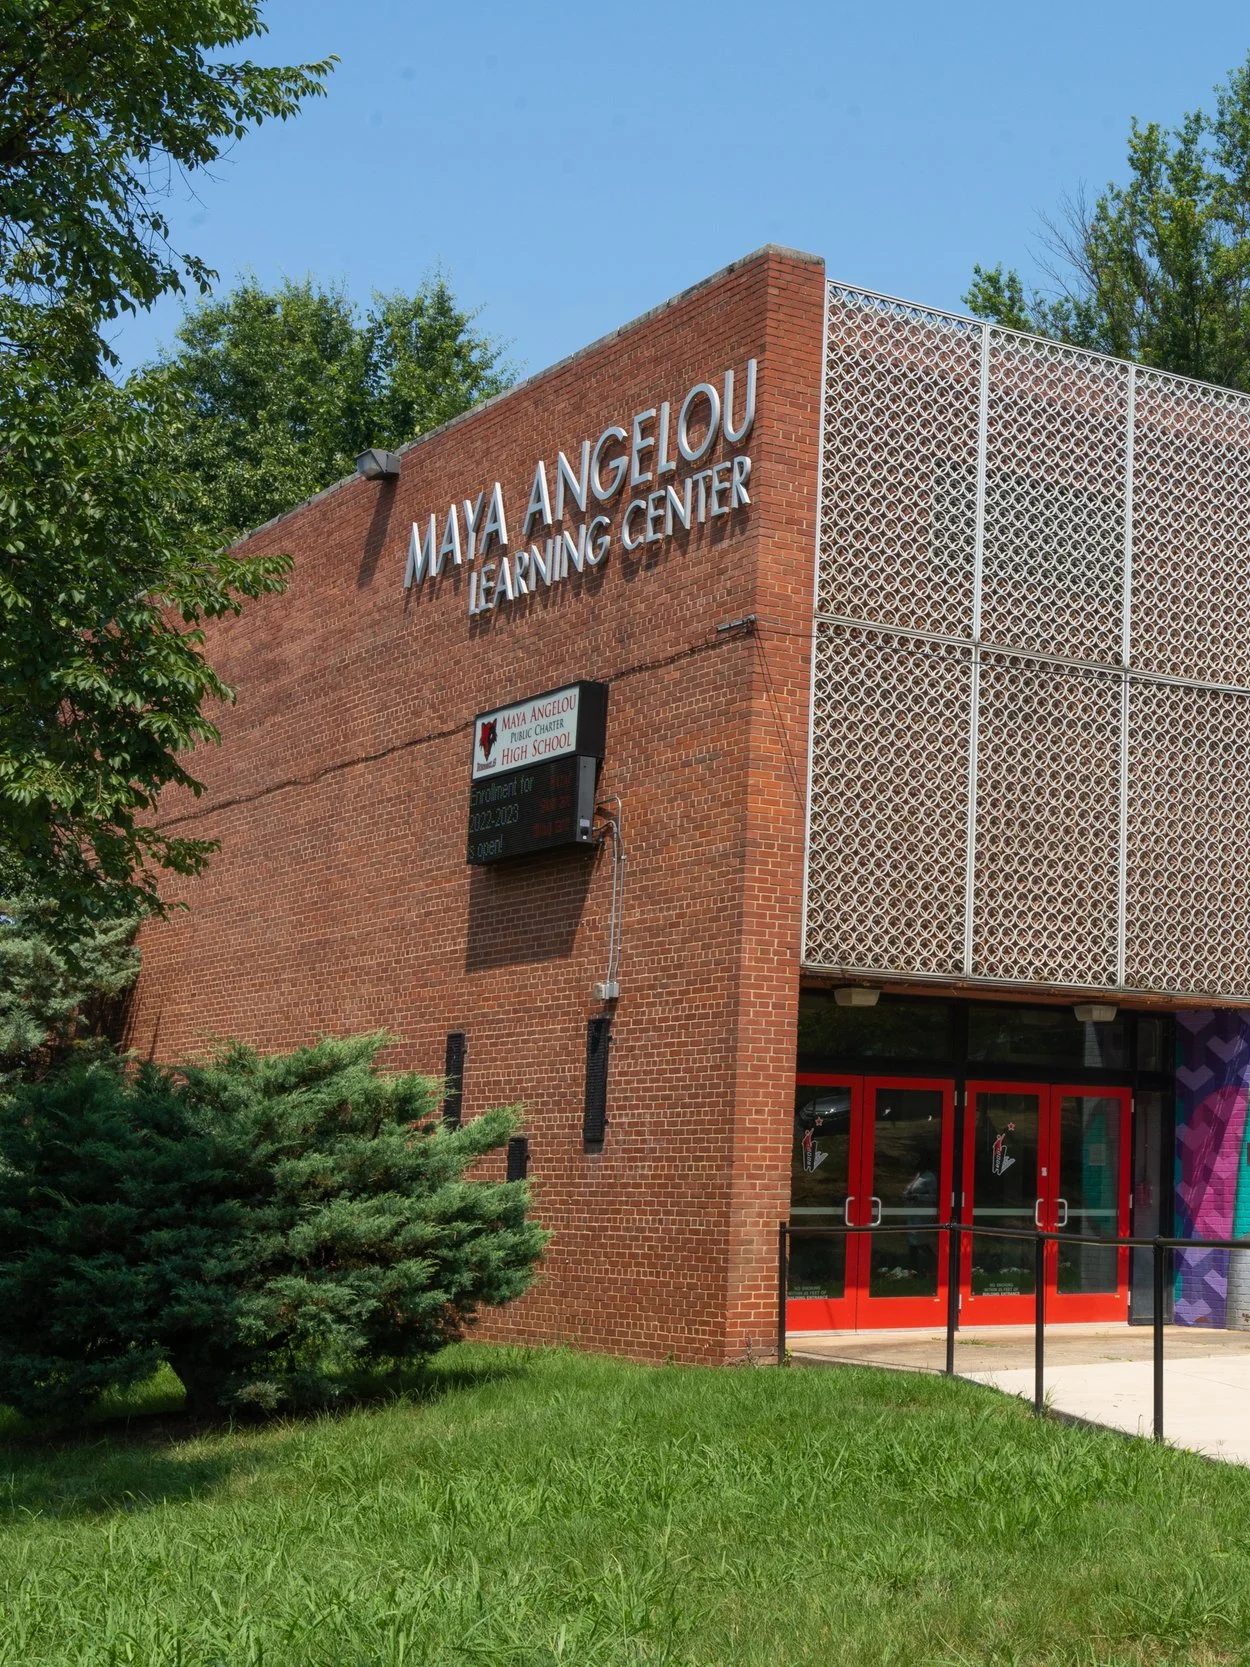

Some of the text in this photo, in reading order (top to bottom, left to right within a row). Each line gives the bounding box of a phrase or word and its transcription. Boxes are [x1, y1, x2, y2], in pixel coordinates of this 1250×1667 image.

[404, 358, 757, 589] MAYA ANGELOU
[469, 456, 751, 616] LEARNING CENTER
[501, 694, 577, 732] MAYA ANGELOU
[510, 718, 564, 743] PUBLIC CHARTER
[501, 745, 528, 766] HIGH
[532, 731, 572, 757] SCHOOL
[470, 776, 517, 807] Enrollment
[520, 775, 535, 794] for
[469, 803, 520, 833] 2022-2023
